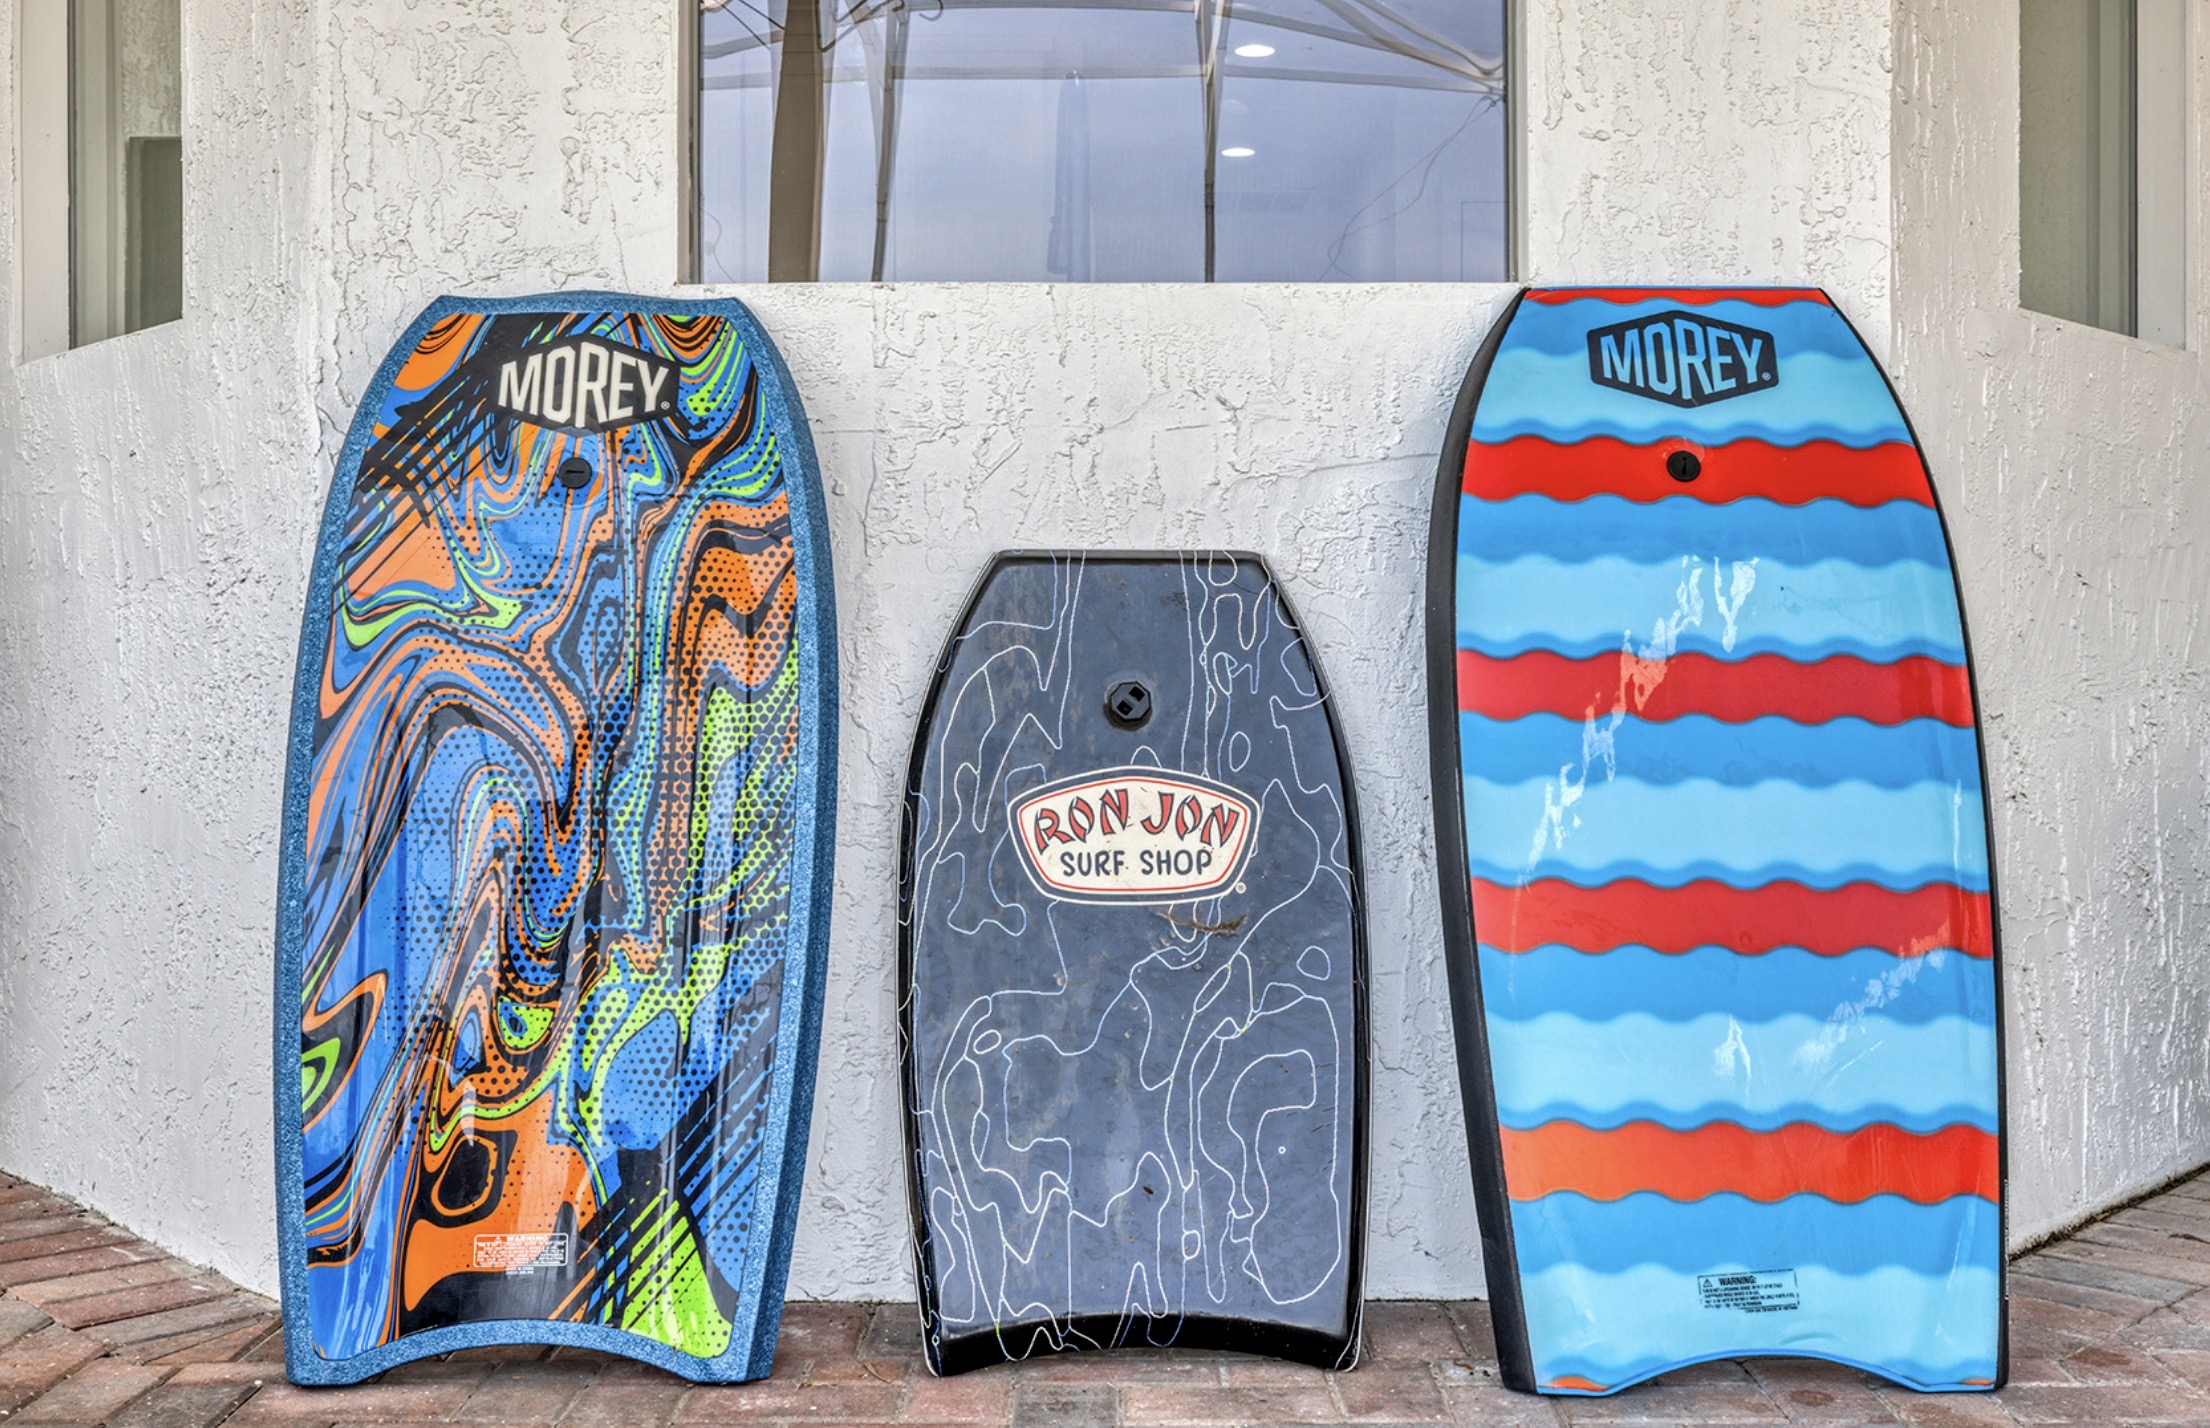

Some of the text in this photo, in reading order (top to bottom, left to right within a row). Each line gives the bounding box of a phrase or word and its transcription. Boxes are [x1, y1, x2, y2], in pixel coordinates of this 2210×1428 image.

[498, 341, 670, 429] MOREY
[1600, 318, 1763, 400] MOREY
[1034, 788, 1240, 855] RON JON
[1060, 849, 1213, 877] SURF SHOP
